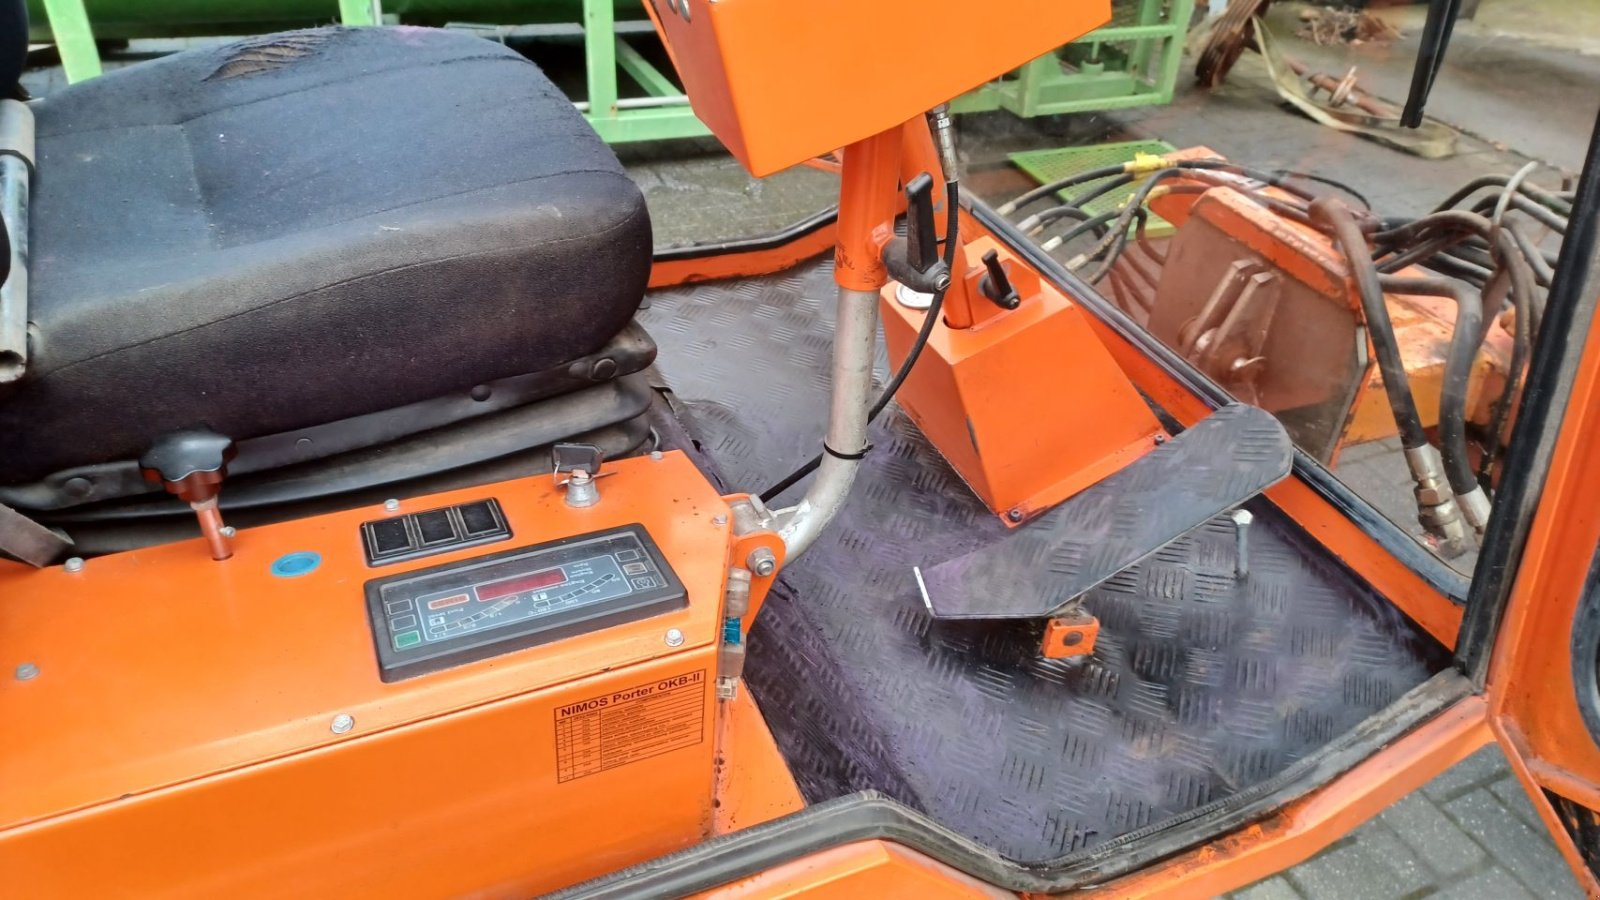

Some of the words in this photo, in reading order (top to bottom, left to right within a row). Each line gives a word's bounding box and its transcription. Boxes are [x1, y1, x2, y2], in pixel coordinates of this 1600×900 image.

[561, 697, 608, 717] NIMOS
[613, 686, 654, 703] Porter
[658, 673, 700, 691] OKB-II
